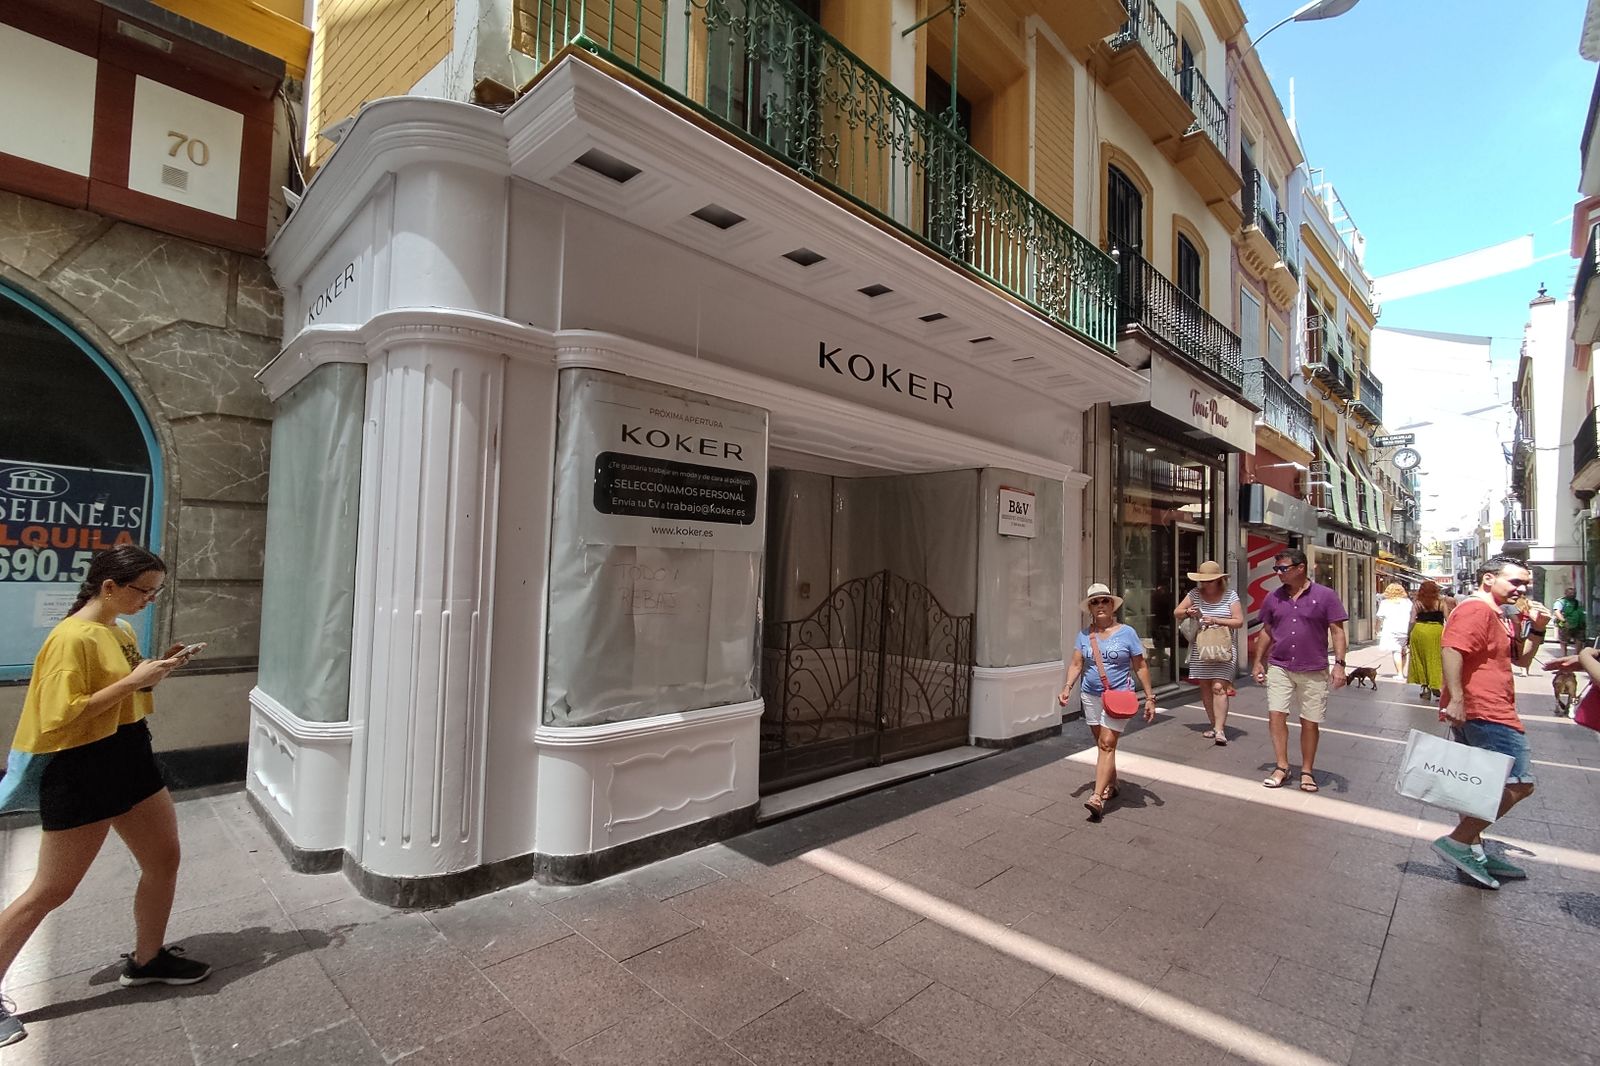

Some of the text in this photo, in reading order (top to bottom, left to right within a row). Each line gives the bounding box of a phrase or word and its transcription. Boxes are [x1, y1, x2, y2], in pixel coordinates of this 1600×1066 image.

[167, 131, 210, 167] 70
[308, 262, 354, 325] KOKER
[818, 341, 954, 410] KOKER
[684, 415, 724, 429] APERTURA
[620, 423, 744, 461] KOKER
[614, 478, 746, 502] SELECCIONAMOS PERSONAL
[637, 499, 648, 508] tu
[665, 501, 746, 517] trabajo@koker.es
[1008, 499, 1029, 515] B&V
[651, 525, 714, 537] www.koker.es
[1423, 762, 1482, 786] MANGO
